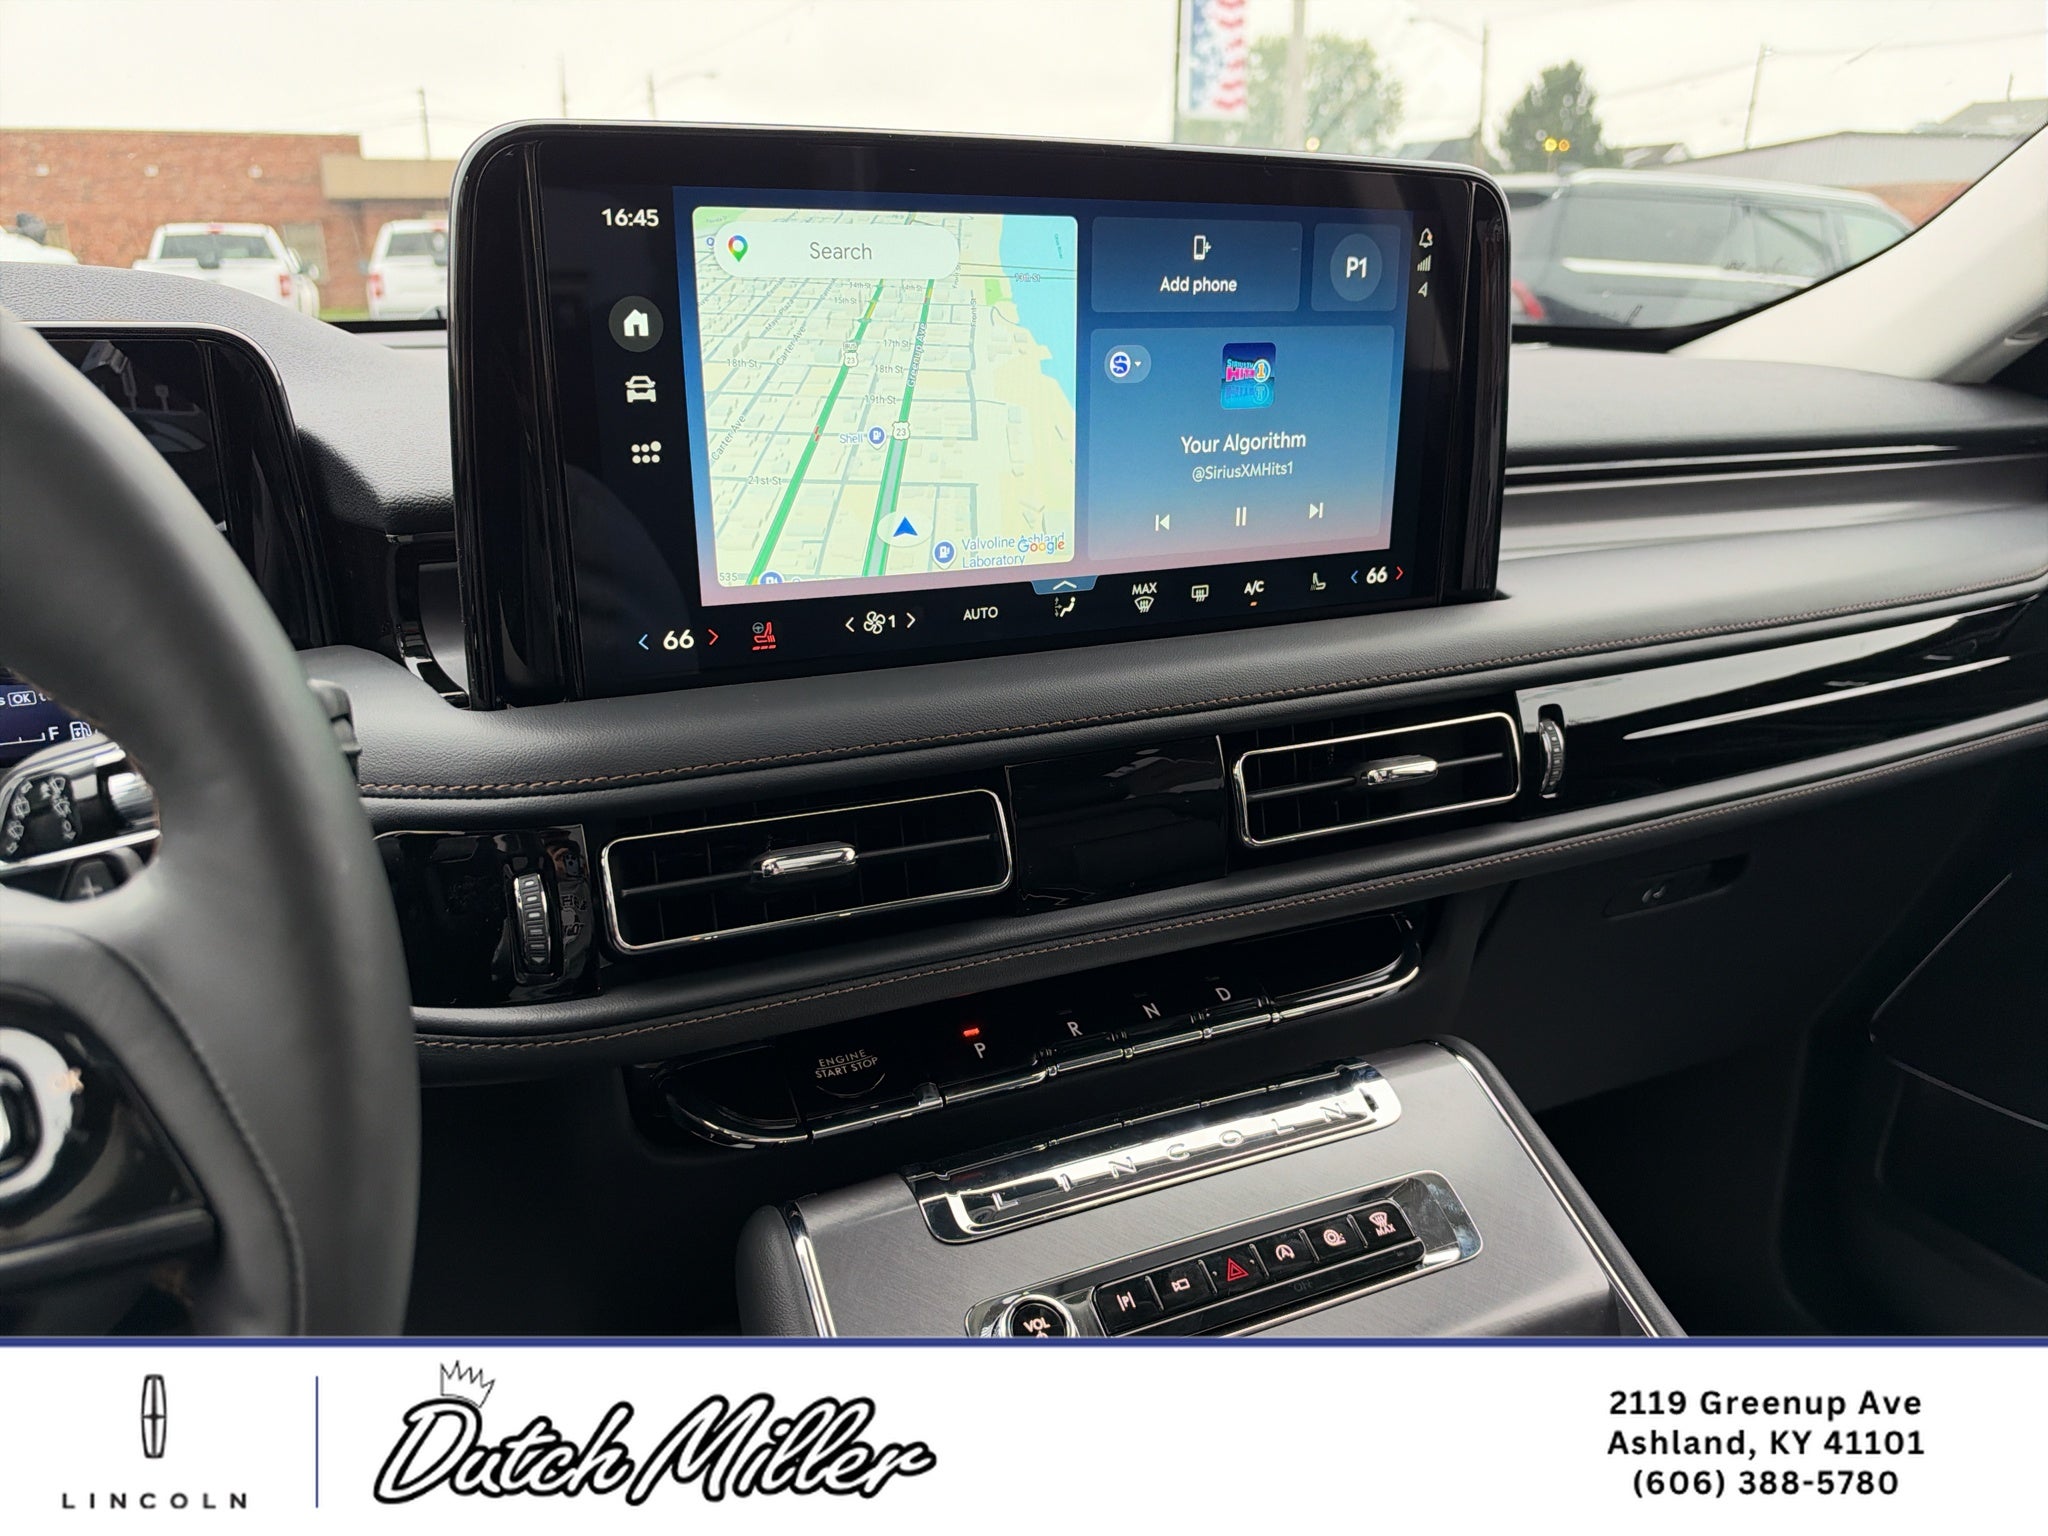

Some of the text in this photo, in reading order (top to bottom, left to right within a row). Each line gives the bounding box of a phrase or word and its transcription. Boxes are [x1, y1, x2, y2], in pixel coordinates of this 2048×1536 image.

[601, 208, 659, 227] 16:45
[809, 241, 872, 260] Search
[1345, 256, 1368, 279] P1
[1160, 276, 1238, 295] Add phone
[970, 306, 978, 328] Front
[776, 326, 806, 366] Carter Ave
[883, 339, 910, 349] 17th St
[846, 356, 856, 364] 23
[906, 322, 927, 388] Greenup Ave
[727, 358, 758, 368] 18th St
[875, 364, 904, 374] 18th St
[865, 394, 896, 405] 19th St
[711, 414, 746, 461] Carter Ave
[839, 433, 864, 444] Shell
[896, 427, 907, 437] 23
[1180, 431, 1307, 454] Your Algorithm
[1191, 461, 1294, 483] @SiriusXMHits1
[748, 475, 782, 486] 21st St
[961, 536, 1015, 551] Valvoline
[1017, 536, 1065, 555] Google
[961, 554, 1026, 569] Laboratory
[719, 572, 738, 582] 535
[1365, 566, 1389, 584] 66
[1131, 582, 1158, 596] MAX
[1244, 580, 1265, 594] A/C
[963, 606, 999, 621] AUTO
[888, 614, 897, 629] 1
[662, 629, 695, 651] 66
[48, 726, 60, 741] F
[1215, 987, 1231, 1002] D
[1142, 1003, 1162, 1020] N
[1067, 1021, 1084, 1037] R
[818, 1048, 867, 1068] ENGINE
[974, 1042, 987, 1060] P
[815, 1056, 879, 1080] START STOP
[992, 1101, 1348, 1211] LINCOLN
[1375, 1223, 1397, 1237] MAX
[1022, 1318, 1051, 1333] VOL
